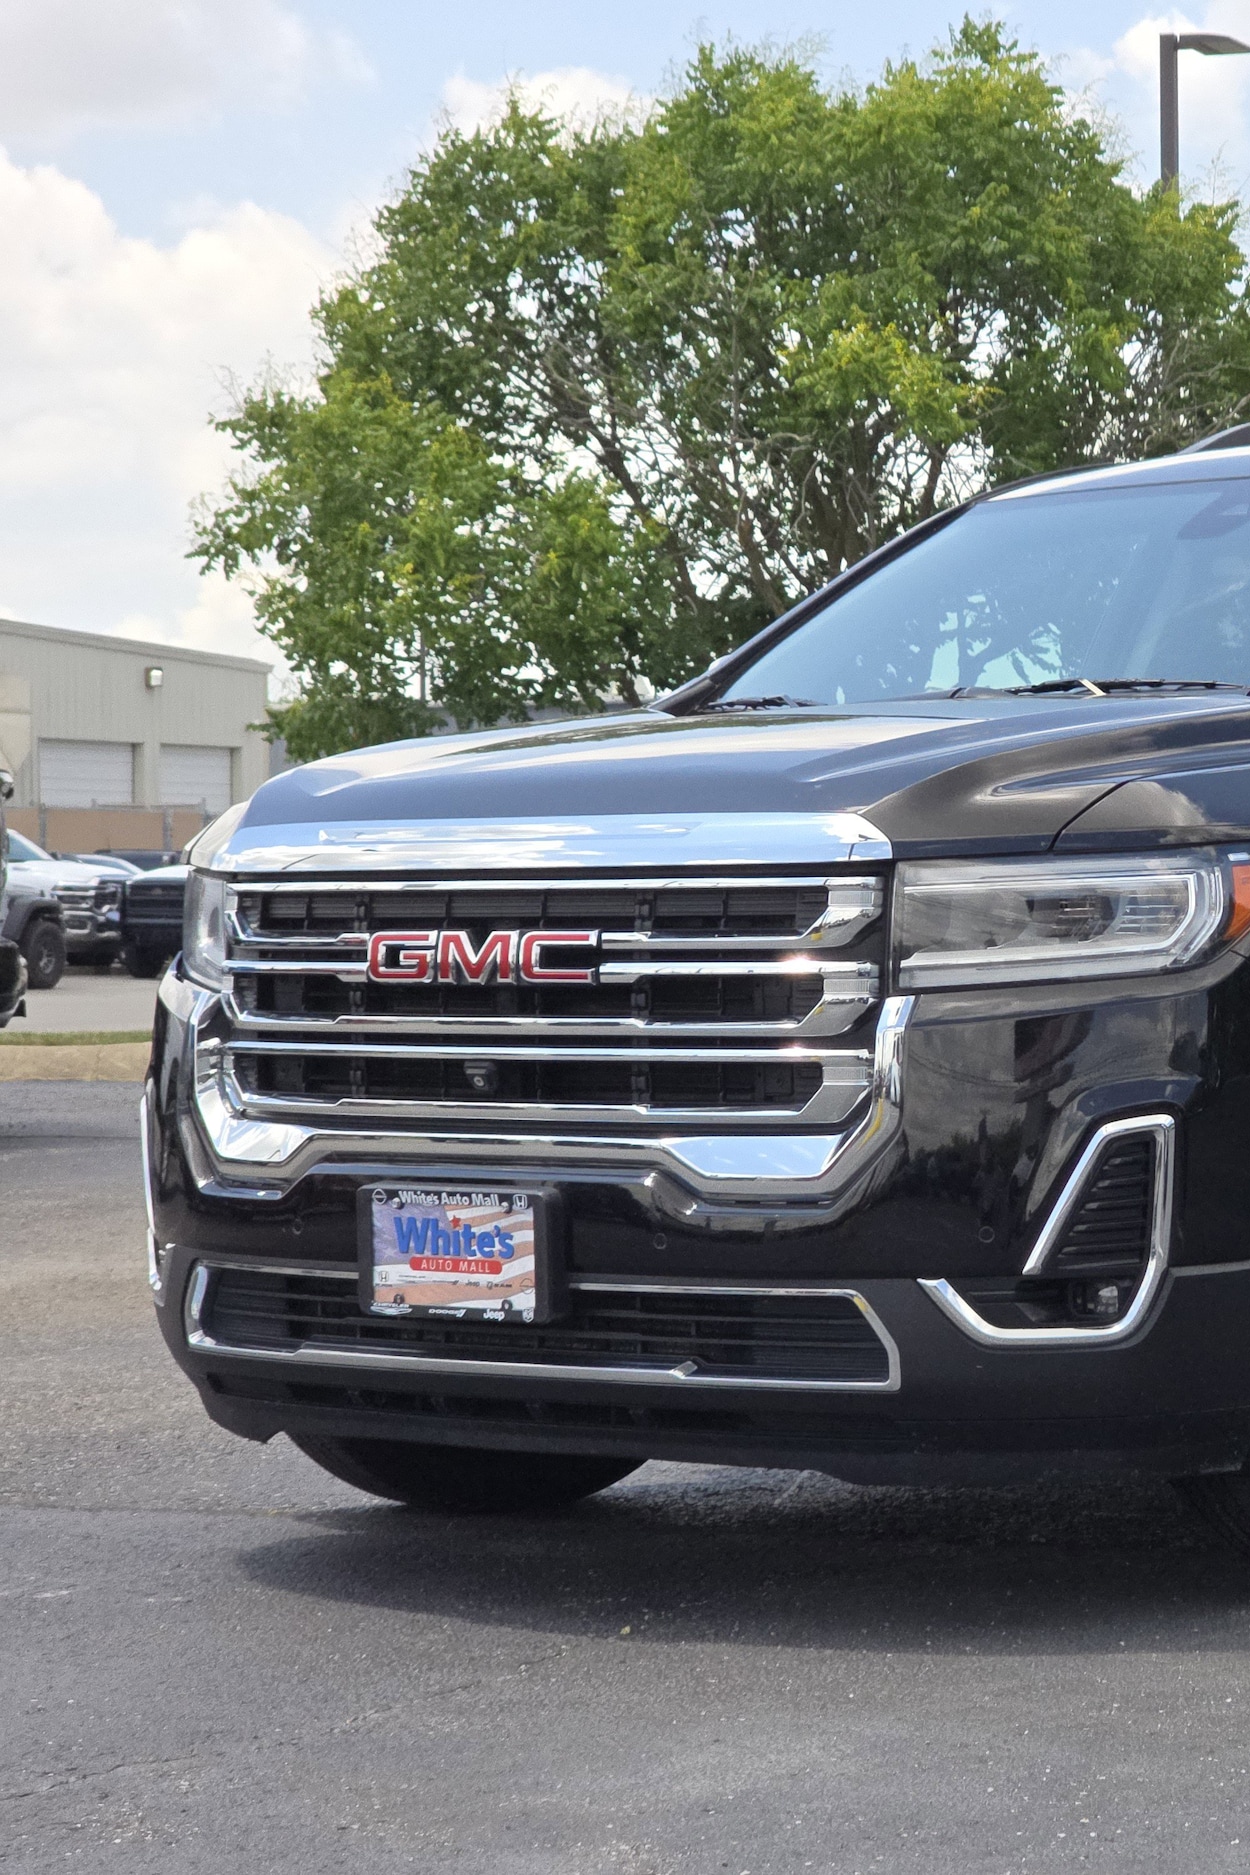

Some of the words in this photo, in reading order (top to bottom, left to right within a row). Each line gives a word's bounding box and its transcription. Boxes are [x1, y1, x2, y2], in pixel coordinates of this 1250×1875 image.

[367, 930, 598, 984] GMC
[398, 1190, 439, 1205] White's
[441, 1191, 470, 1205] Auto
[472, 1193, 499, 1206] Mall
[393, 1216, 515, 1259] White's
[420, 1260, 452, 1271] AUTO
[458, 1261, 491, 1273] MALL
[483, 1308, 505, 1321] Jeep
